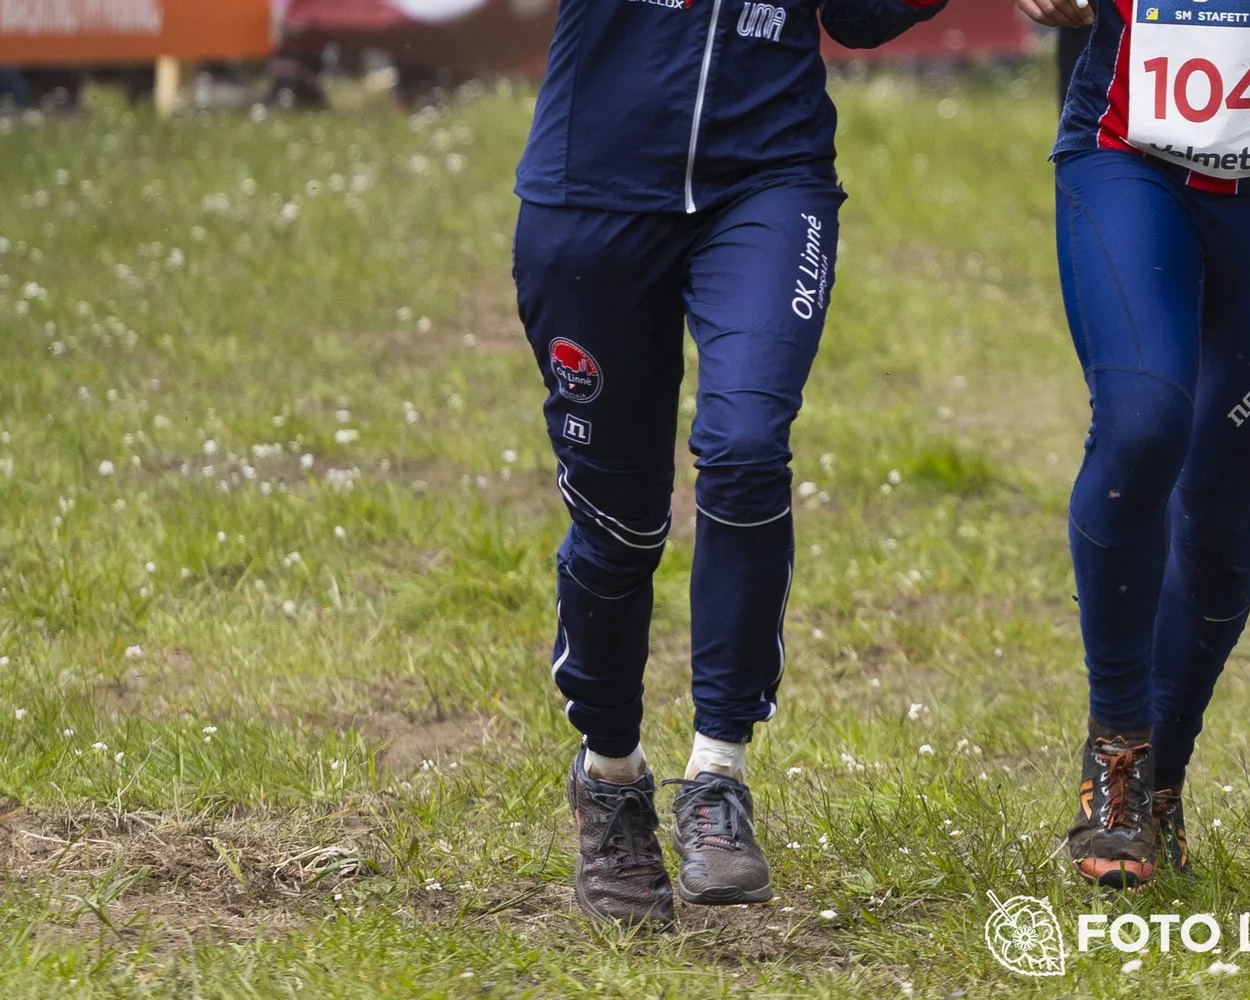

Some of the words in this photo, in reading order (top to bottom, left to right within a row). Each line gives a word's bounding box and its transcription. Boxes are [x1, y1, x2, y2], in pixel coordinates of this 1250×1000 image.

[736, 1, 786, 42] UMA
[1175, 11, 1192, 20] SM
[1198, 12, 1249, 22] STAFETT
[798, 213, 822, 281] Linné
[791, 279, 817, 320] OK
[567, 372, 592, 386] Linné
